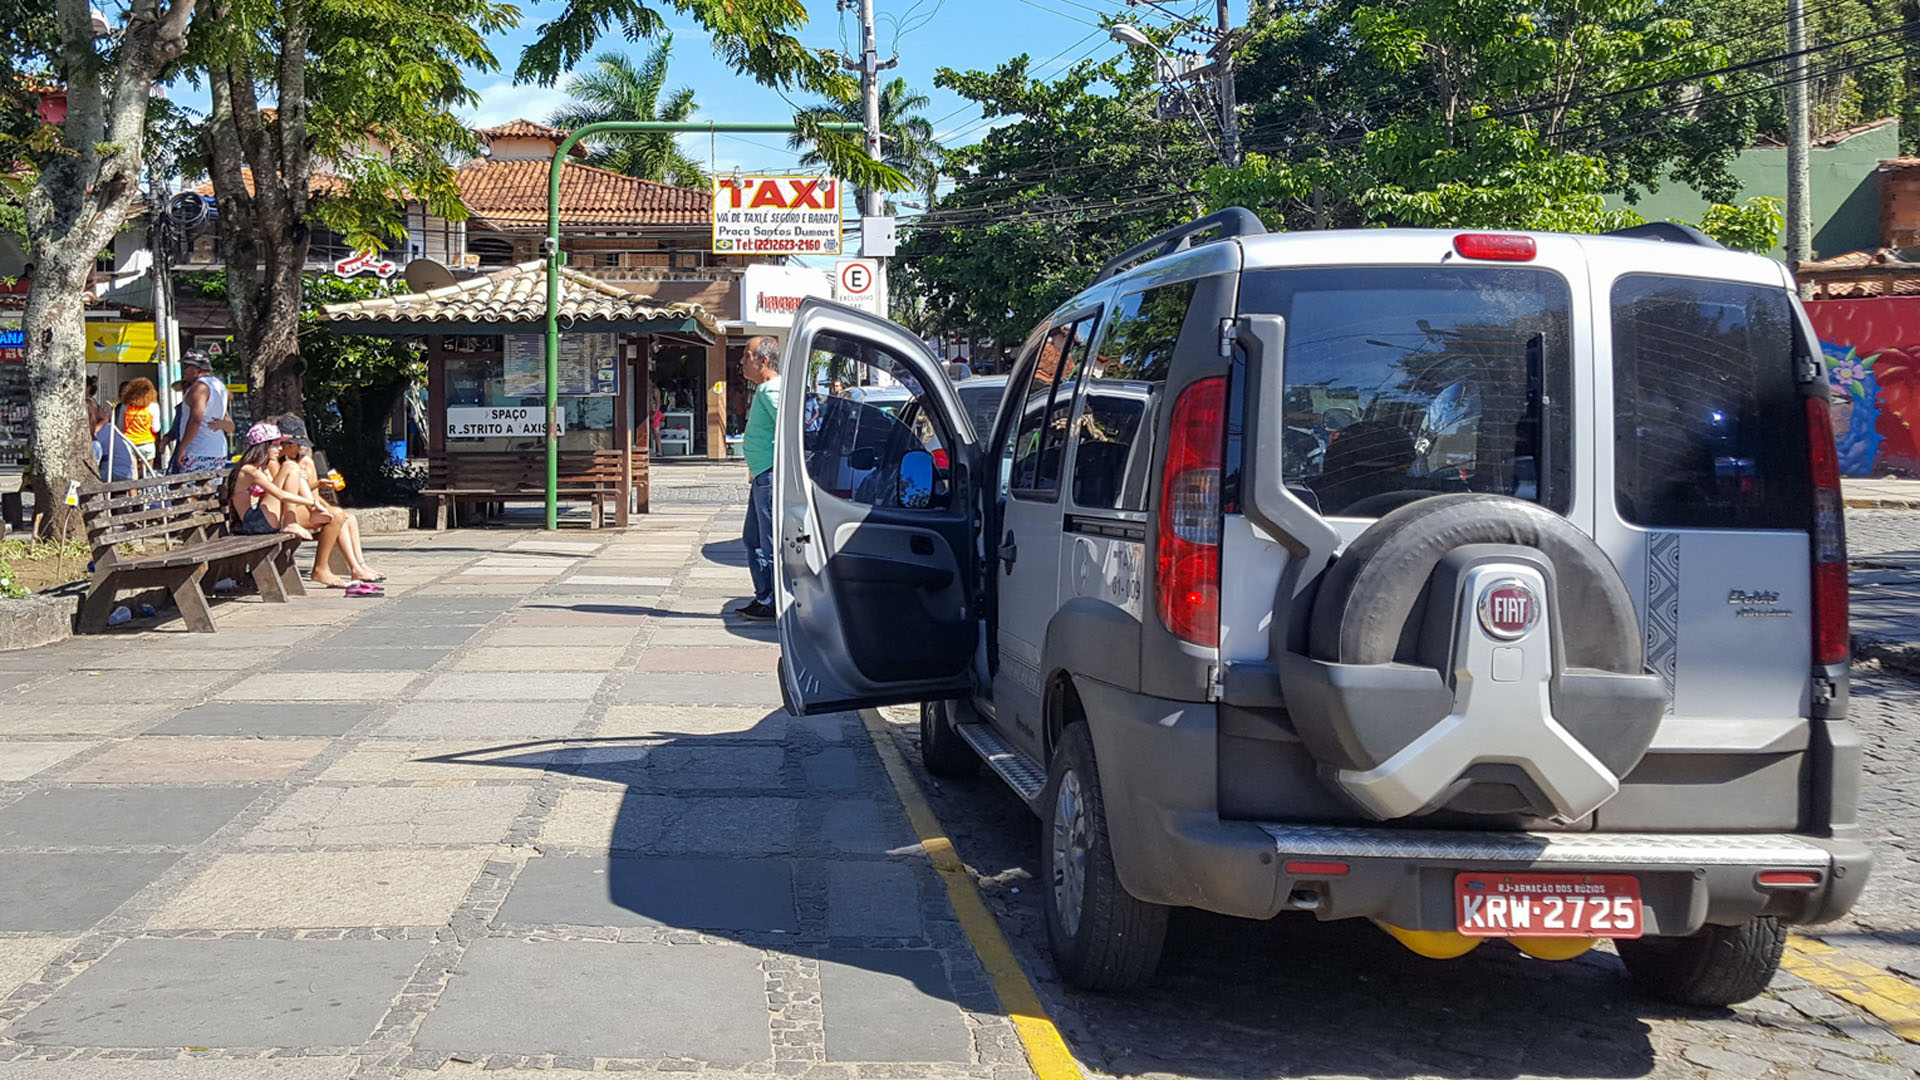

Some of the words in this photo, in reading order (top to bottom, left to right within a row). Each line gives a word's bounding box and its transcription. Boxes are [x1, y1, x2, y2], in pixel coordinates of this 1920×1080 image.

[719, 180, 835, 209] TAXI
[732, 213, 741, 222] DE
[771, 213, 800, 223] SEGURO
[802, 213, 806, 223] E
[808, 213, 839, 223] BARATO
[719, 226, 750, 236] Praça
[754, 226, 791, 236] Santos
[795, 226, 835, 236] Dumont
[852, 271, 862, 287] E
[839, 294, 874, 302] EXCLUSIVO
[449, 424, 502, 435] RSTRITO
[507, 424, 514, 434] A
[1495, 597, 1527, 623] FIAT
[1498, 883, 1553, 894] RJ-ARMAÇÃO
[1556, 884, 1573, 893] DOS
[1575, 884, 1606, 894] BÚZIOS
